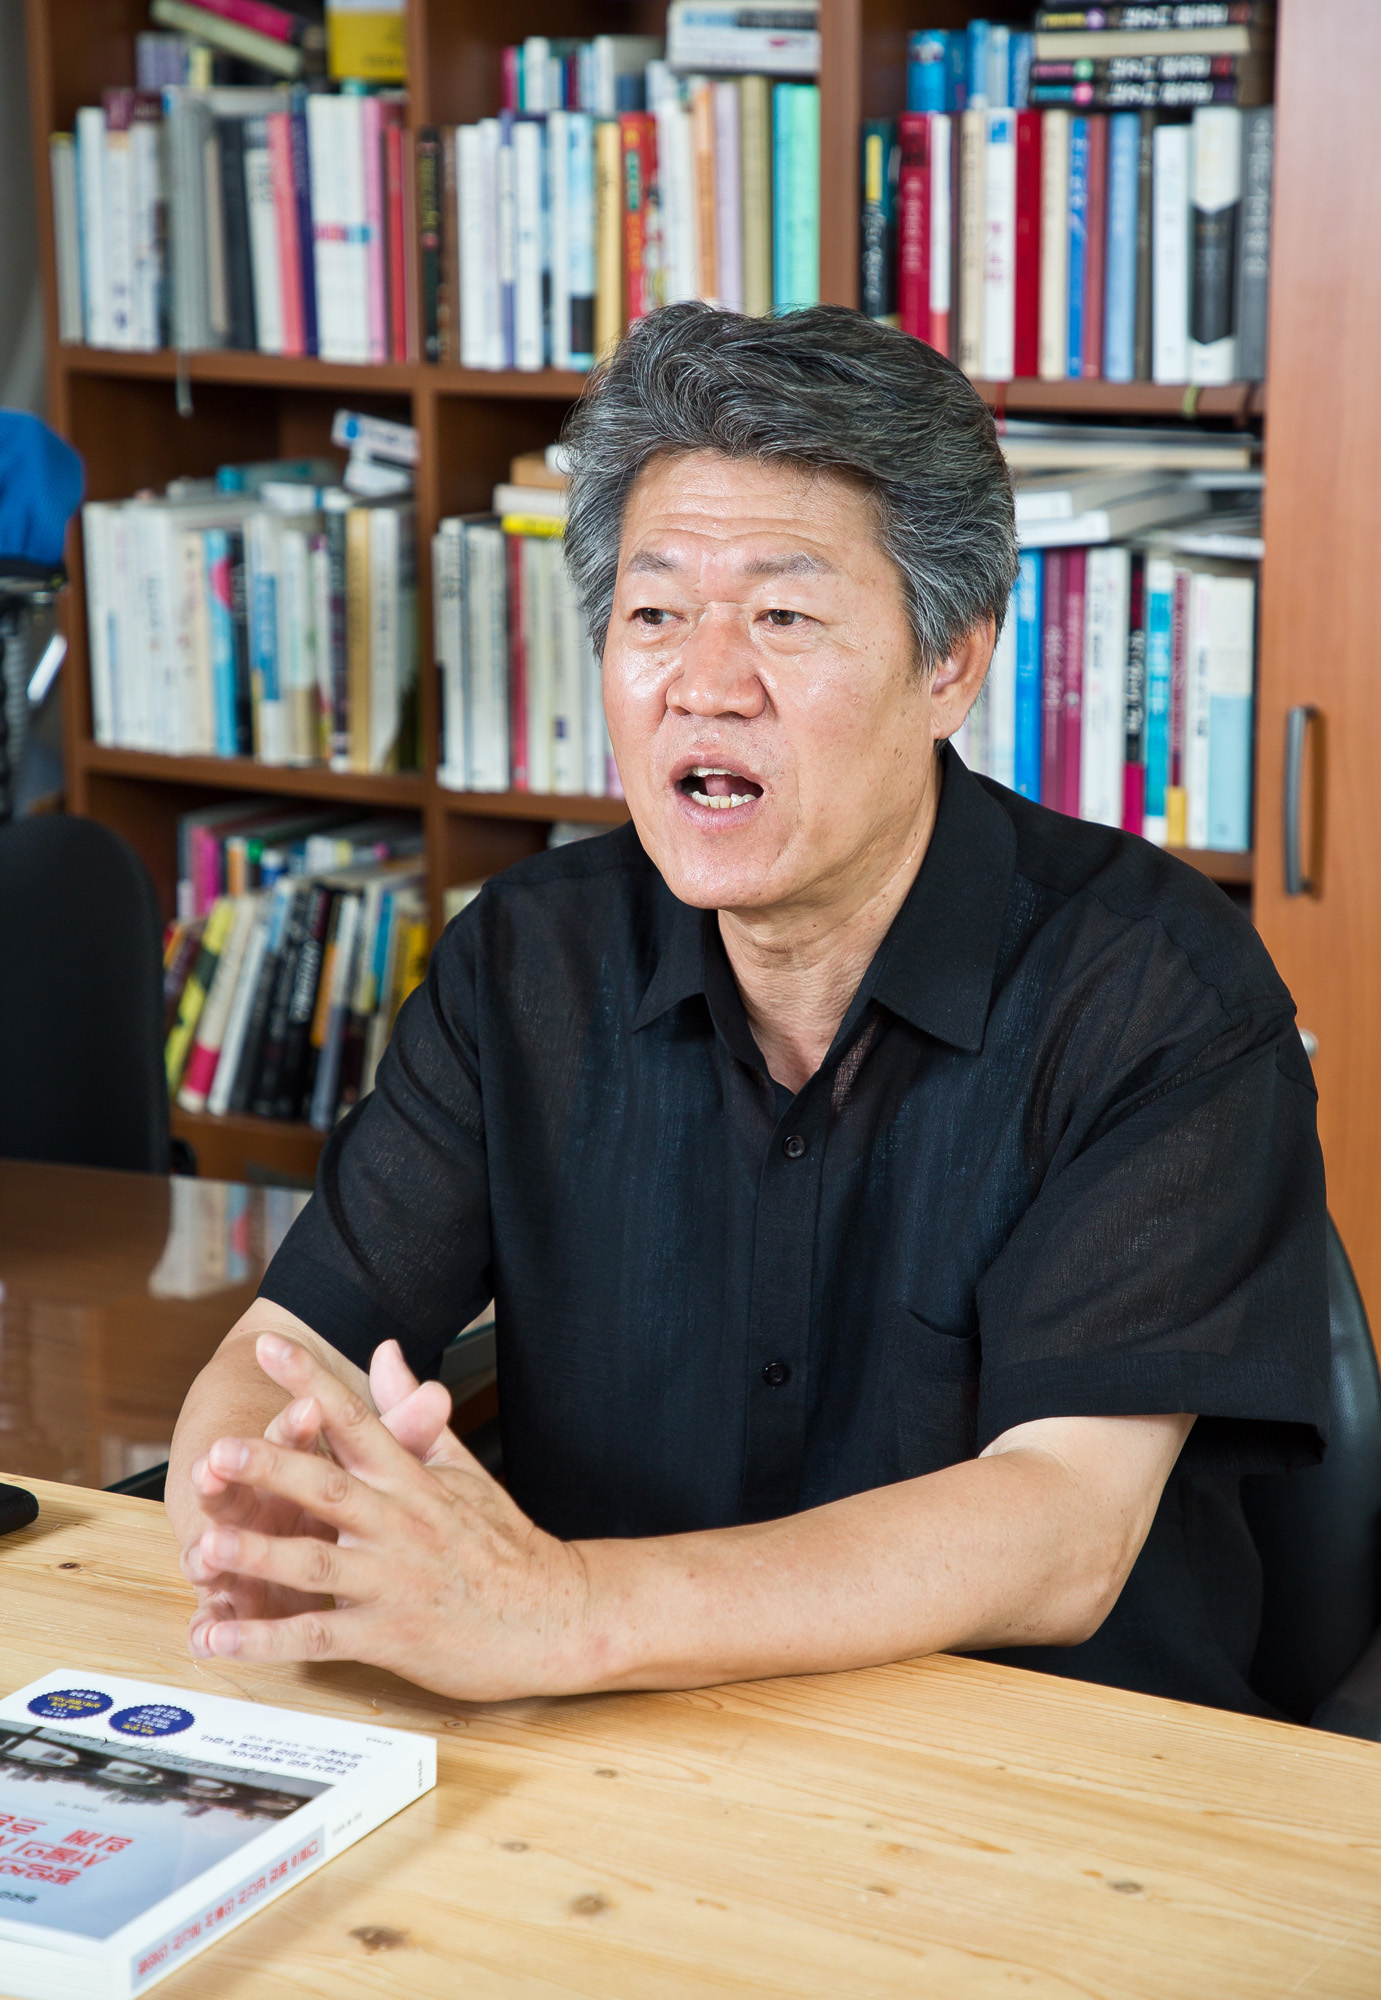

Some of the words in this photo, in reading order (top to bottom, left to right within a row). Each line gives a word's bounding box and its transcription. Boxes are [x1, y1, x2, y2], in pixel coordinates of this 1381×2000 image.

[61, 1829, 134, 1852] 함께
[11, 1841, 110, 1868] 서울의
[138, 1944, 168, 1976] 평양의
[173, 1922, 202, 1951] 시간은
[205, 1898, 234, 1928] 서울의
[238, 1876, 266, 1905] 시간과
[269, 1860, 288, 1884] 함께
[291, 1840, 318, 1869] 흐른다
